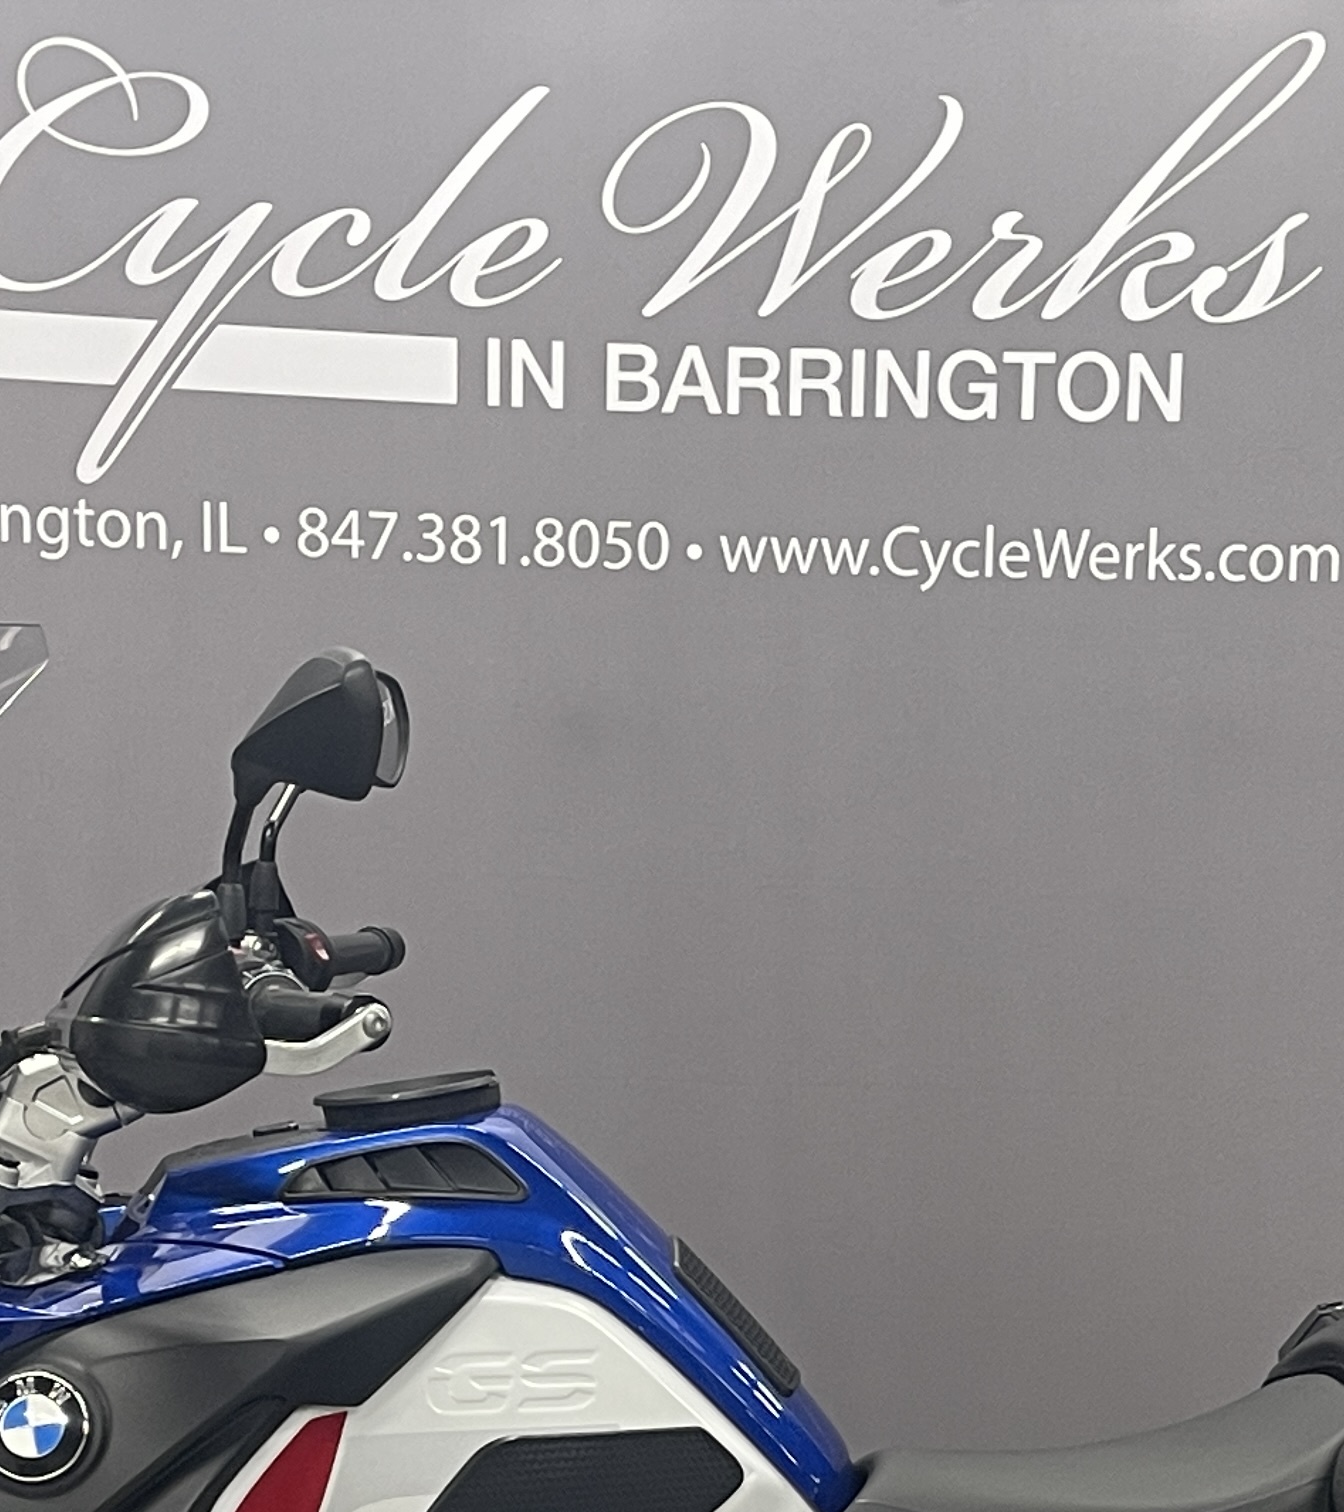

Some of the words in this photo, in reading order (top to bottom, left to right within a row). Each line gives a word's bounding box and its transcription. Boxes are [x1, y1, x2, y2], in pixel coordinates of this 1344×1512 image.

[600, 29, 1328, 324] Werks
[486, 336, 565, 410] IN
[605, 341, 1184, 423] BARRINGTON
[202, 499, 249, 555] IL
[296, 506, 671, 572] 847.381.8050
[718, 524, 1341, 593] www.CycleWerks.com
[427, 1347, 601, 1415] GS
